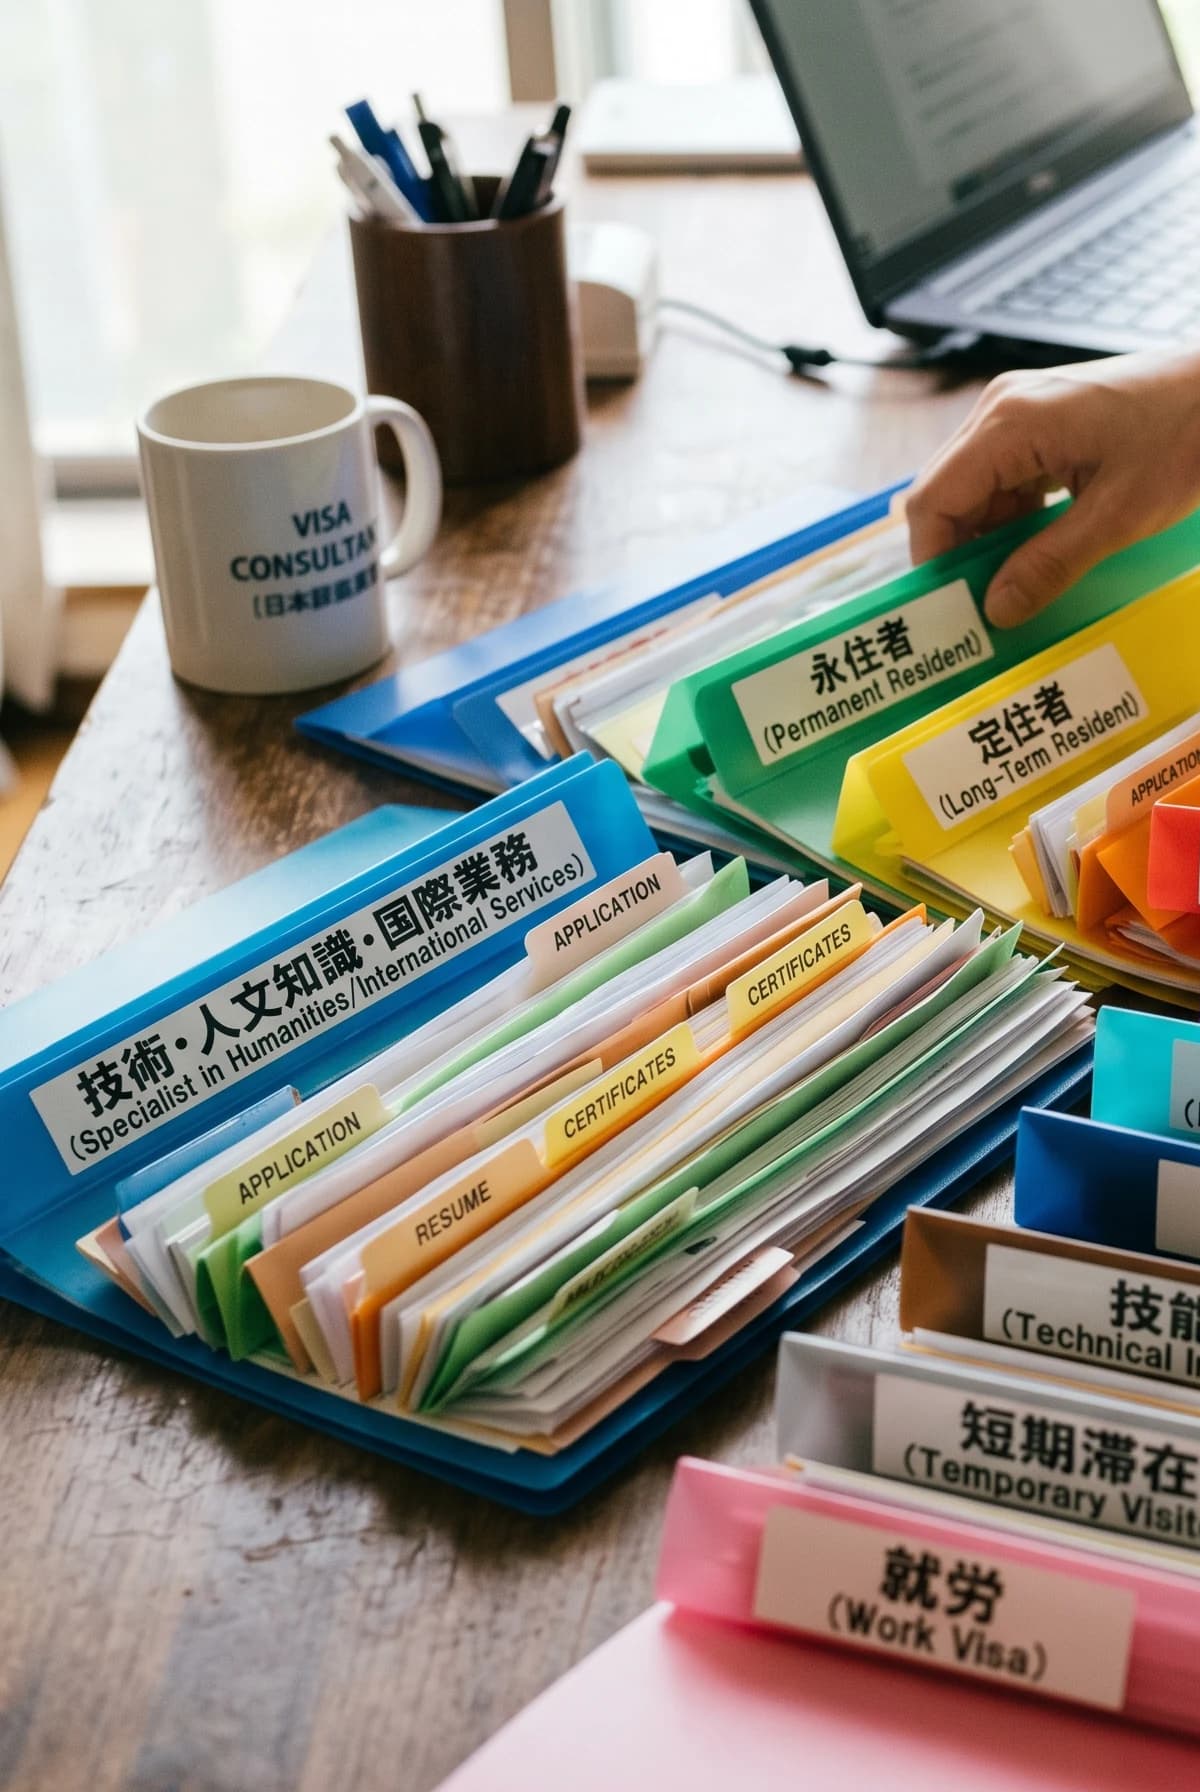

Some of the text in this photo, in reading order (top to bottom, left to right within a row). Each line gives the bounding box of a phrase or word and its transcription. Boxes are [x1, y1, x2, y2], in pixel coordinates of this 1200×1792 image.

[292, 499, 352, 538] VISA
[764, 629, 982, 754] (Permanent Resident)
[810, 616, 915, 696] 永住者
[939, 691, 1140, 820] (Long-Term Resident)
[968, 681, 1072, 765] 定住者
[553, 873, 662, 952] APPLICATION
[71, 852, 588, 1161] (Specialist in Humanities/International Services)
[76, 831, 539, 1118] 技術・人文知識・国際業務
[747, 923, 852, 1007] CERTIFICATES
[563, 1047, 676, 1139] CERTIFICATES
[237, 1112, 362, 1205] APPLICATION
[415, 1181, 492, 1248] RESUME
[1002, 1307, 1173, 1373] (Technical
[902, 1443, 1107, 1520] (Temporary
[961, 1400, 1200, 1500] 短期滞在
[880, 1546, 1004, 1625] 就労
[828, 1594, 1048, 1683] (Work Visa)
